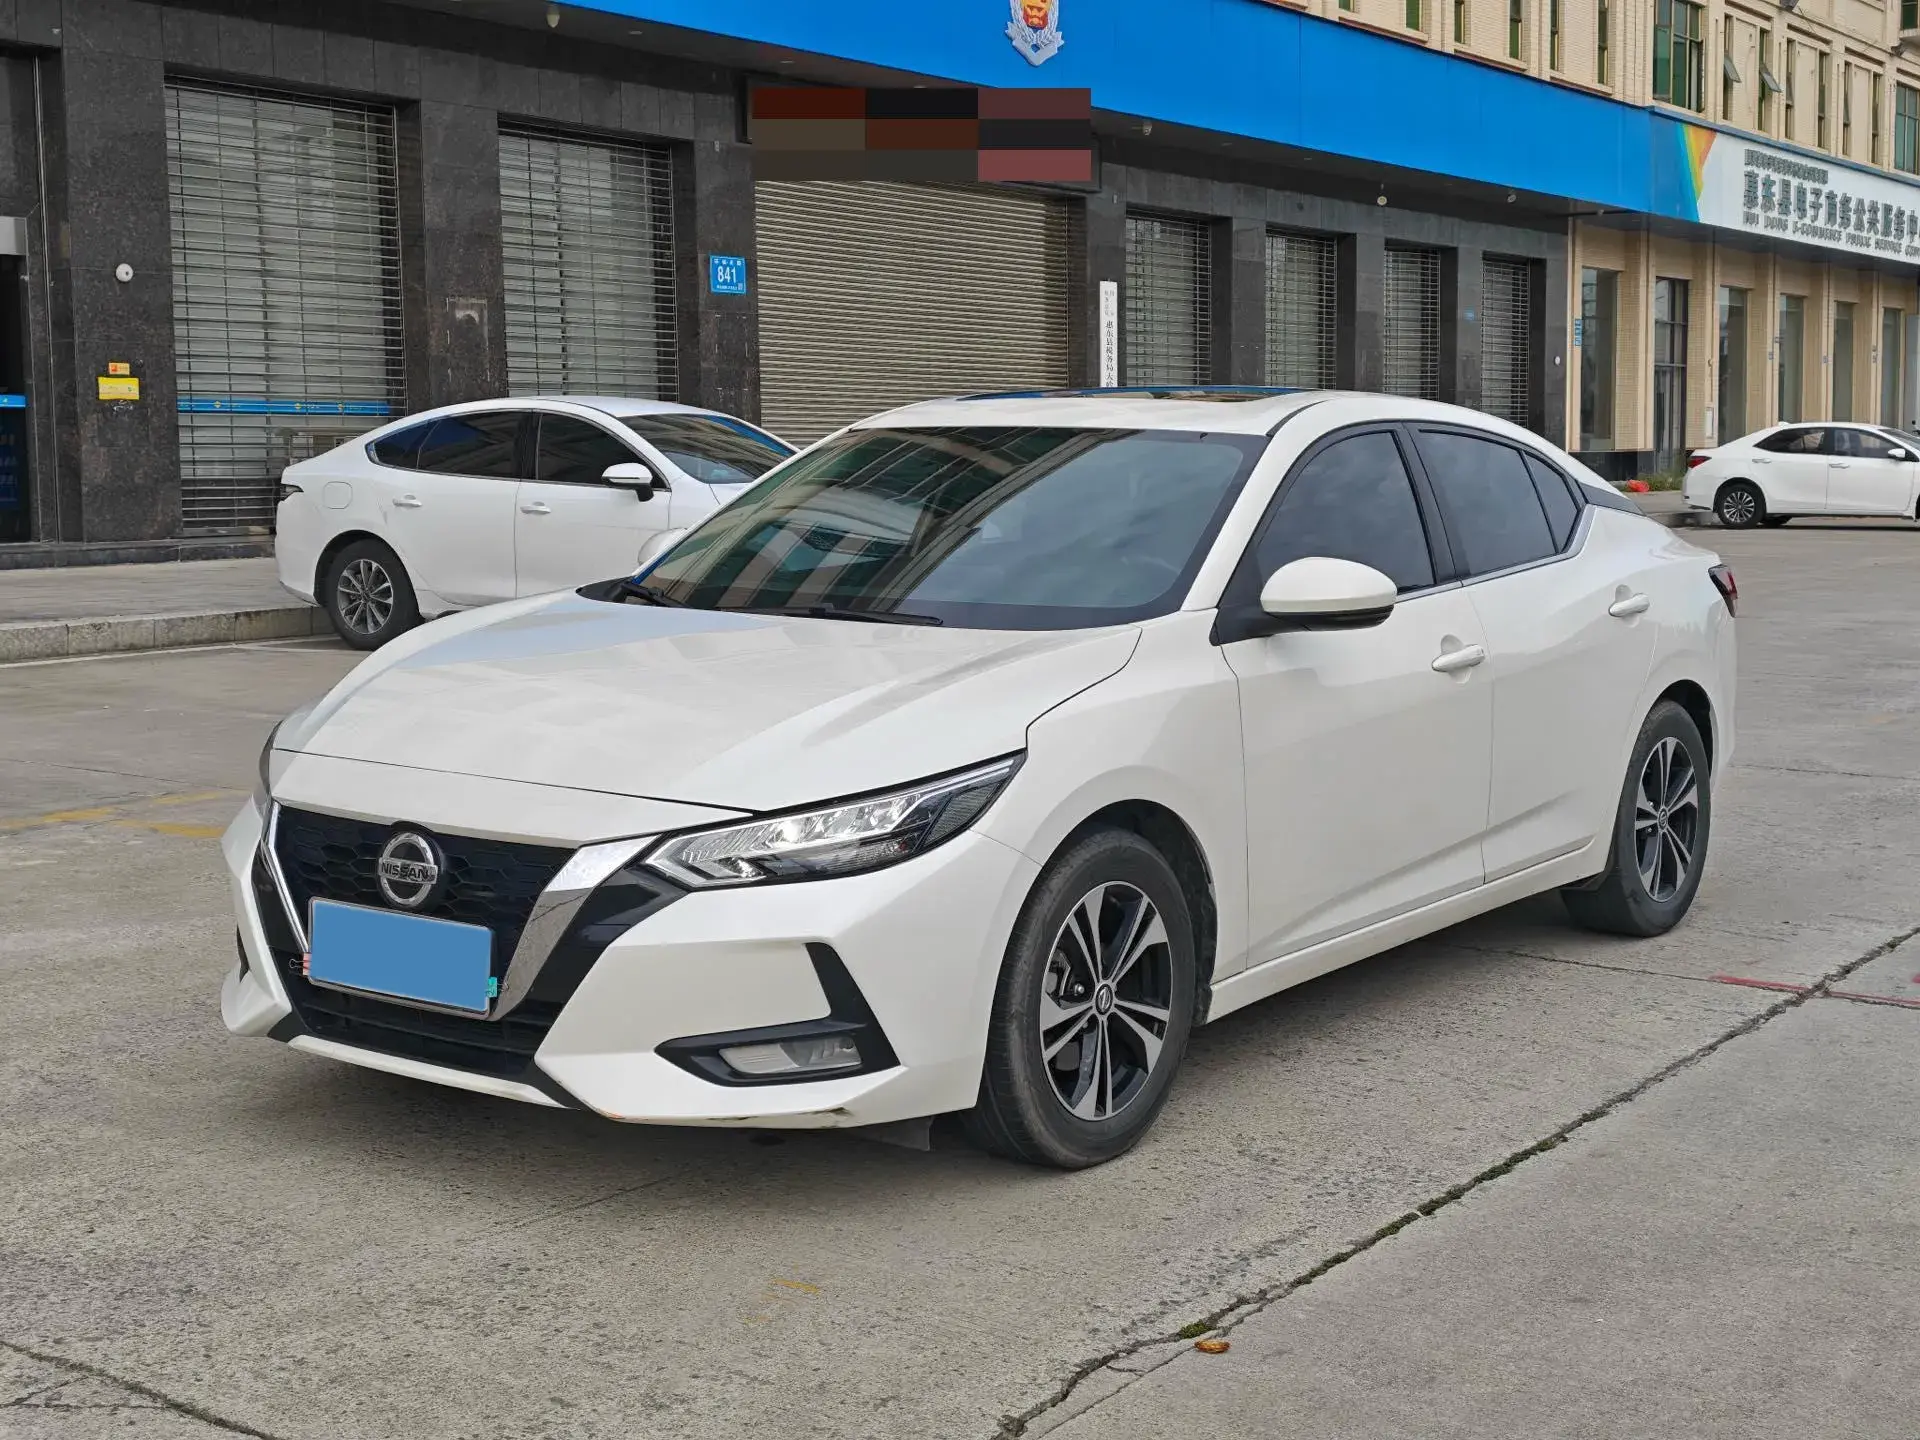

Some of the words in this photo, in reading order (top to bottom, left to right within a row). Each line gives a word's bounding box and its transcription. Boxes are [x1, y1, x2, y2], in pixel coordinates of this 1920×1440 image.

[1743, 170, 1920, 244] 惠东县电子商务公共服务中
[717, 266, 736, 284] 841
[380, 861, 430, 881] NISSAN
